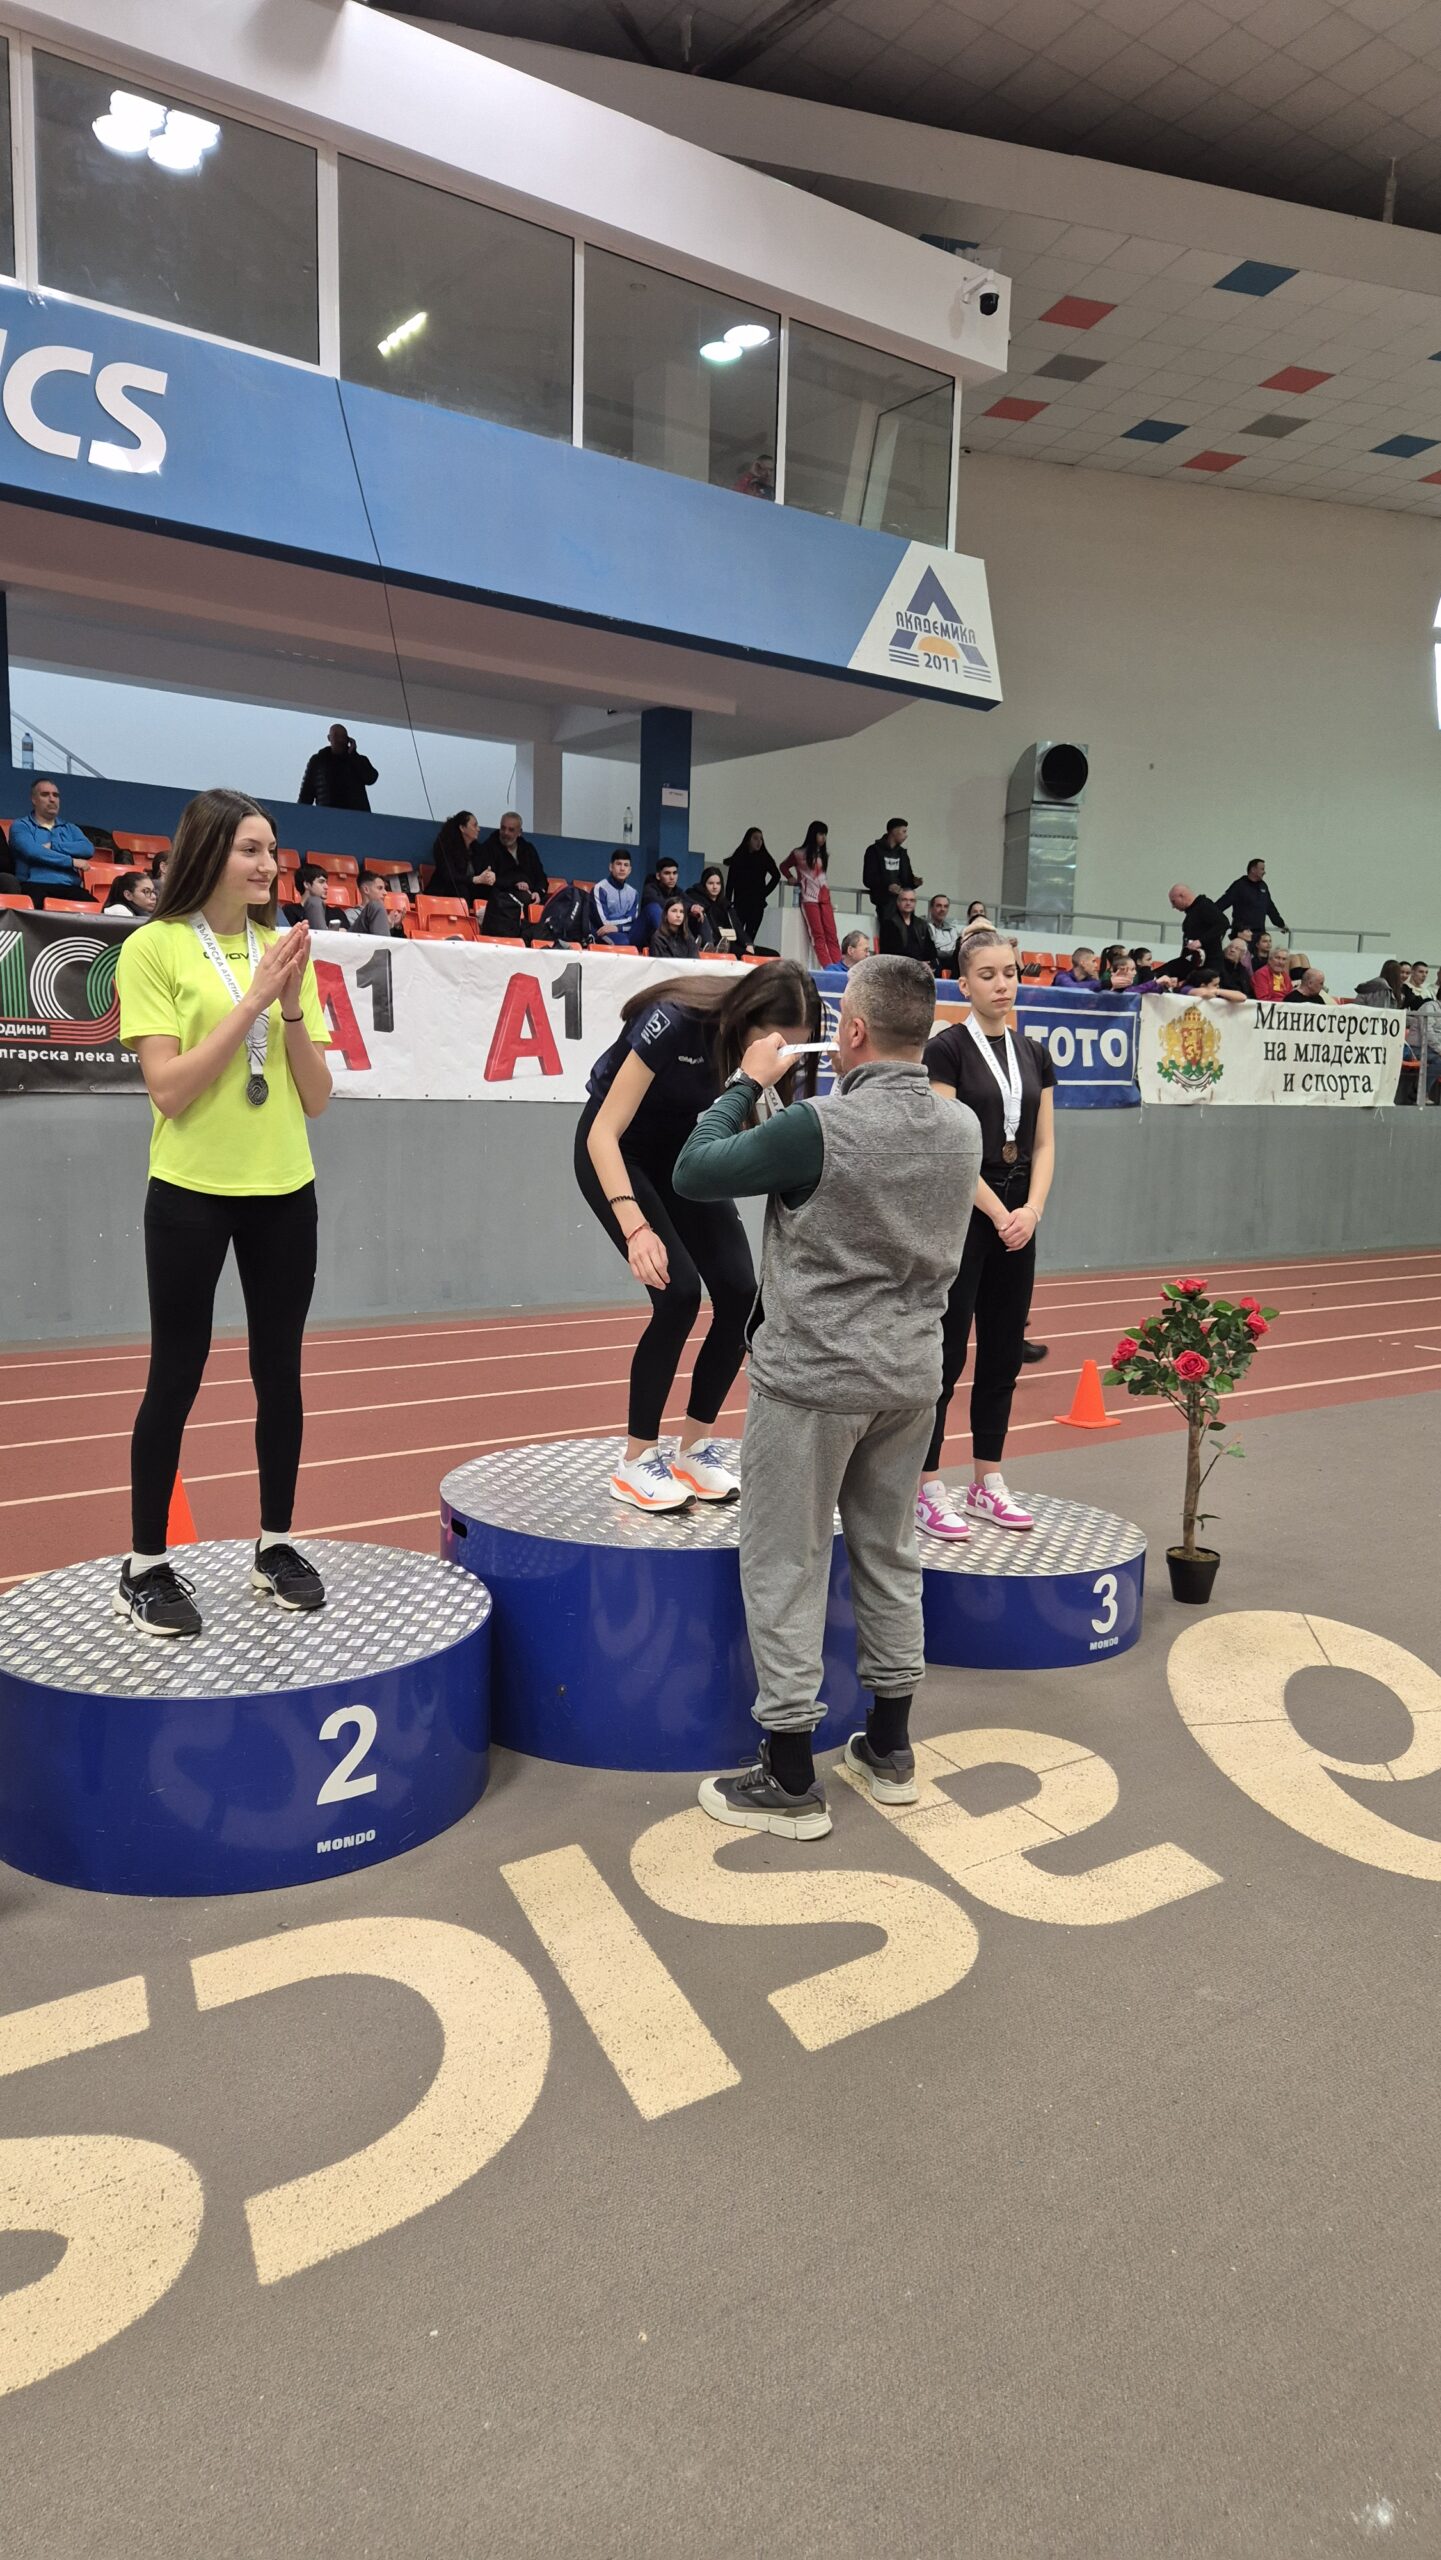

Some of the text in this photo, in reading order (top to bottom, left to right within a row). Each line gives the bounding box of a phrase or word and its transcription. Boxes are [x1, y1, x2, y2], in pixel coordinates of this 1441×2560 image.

[895, 611, 977, 645] АКАДЕМИКА
[923, 652, 959, 674] 2011
[1253, 1002, 1401, 1041] Министерство
[74, 1051, 115, 1063] лека
[120, 1053, 141, 1063] ат
[1264, 1041, 1286, 1061] на
[1283, 1073, 1374, 1100] и спорта
[1091, 1573, 1118, 1634] 3
[1089, 1636, 1119, 1651] MONDO
[316, 1704, 378, 1806] 2
[316, 1829, 377, 1854] MONDO
